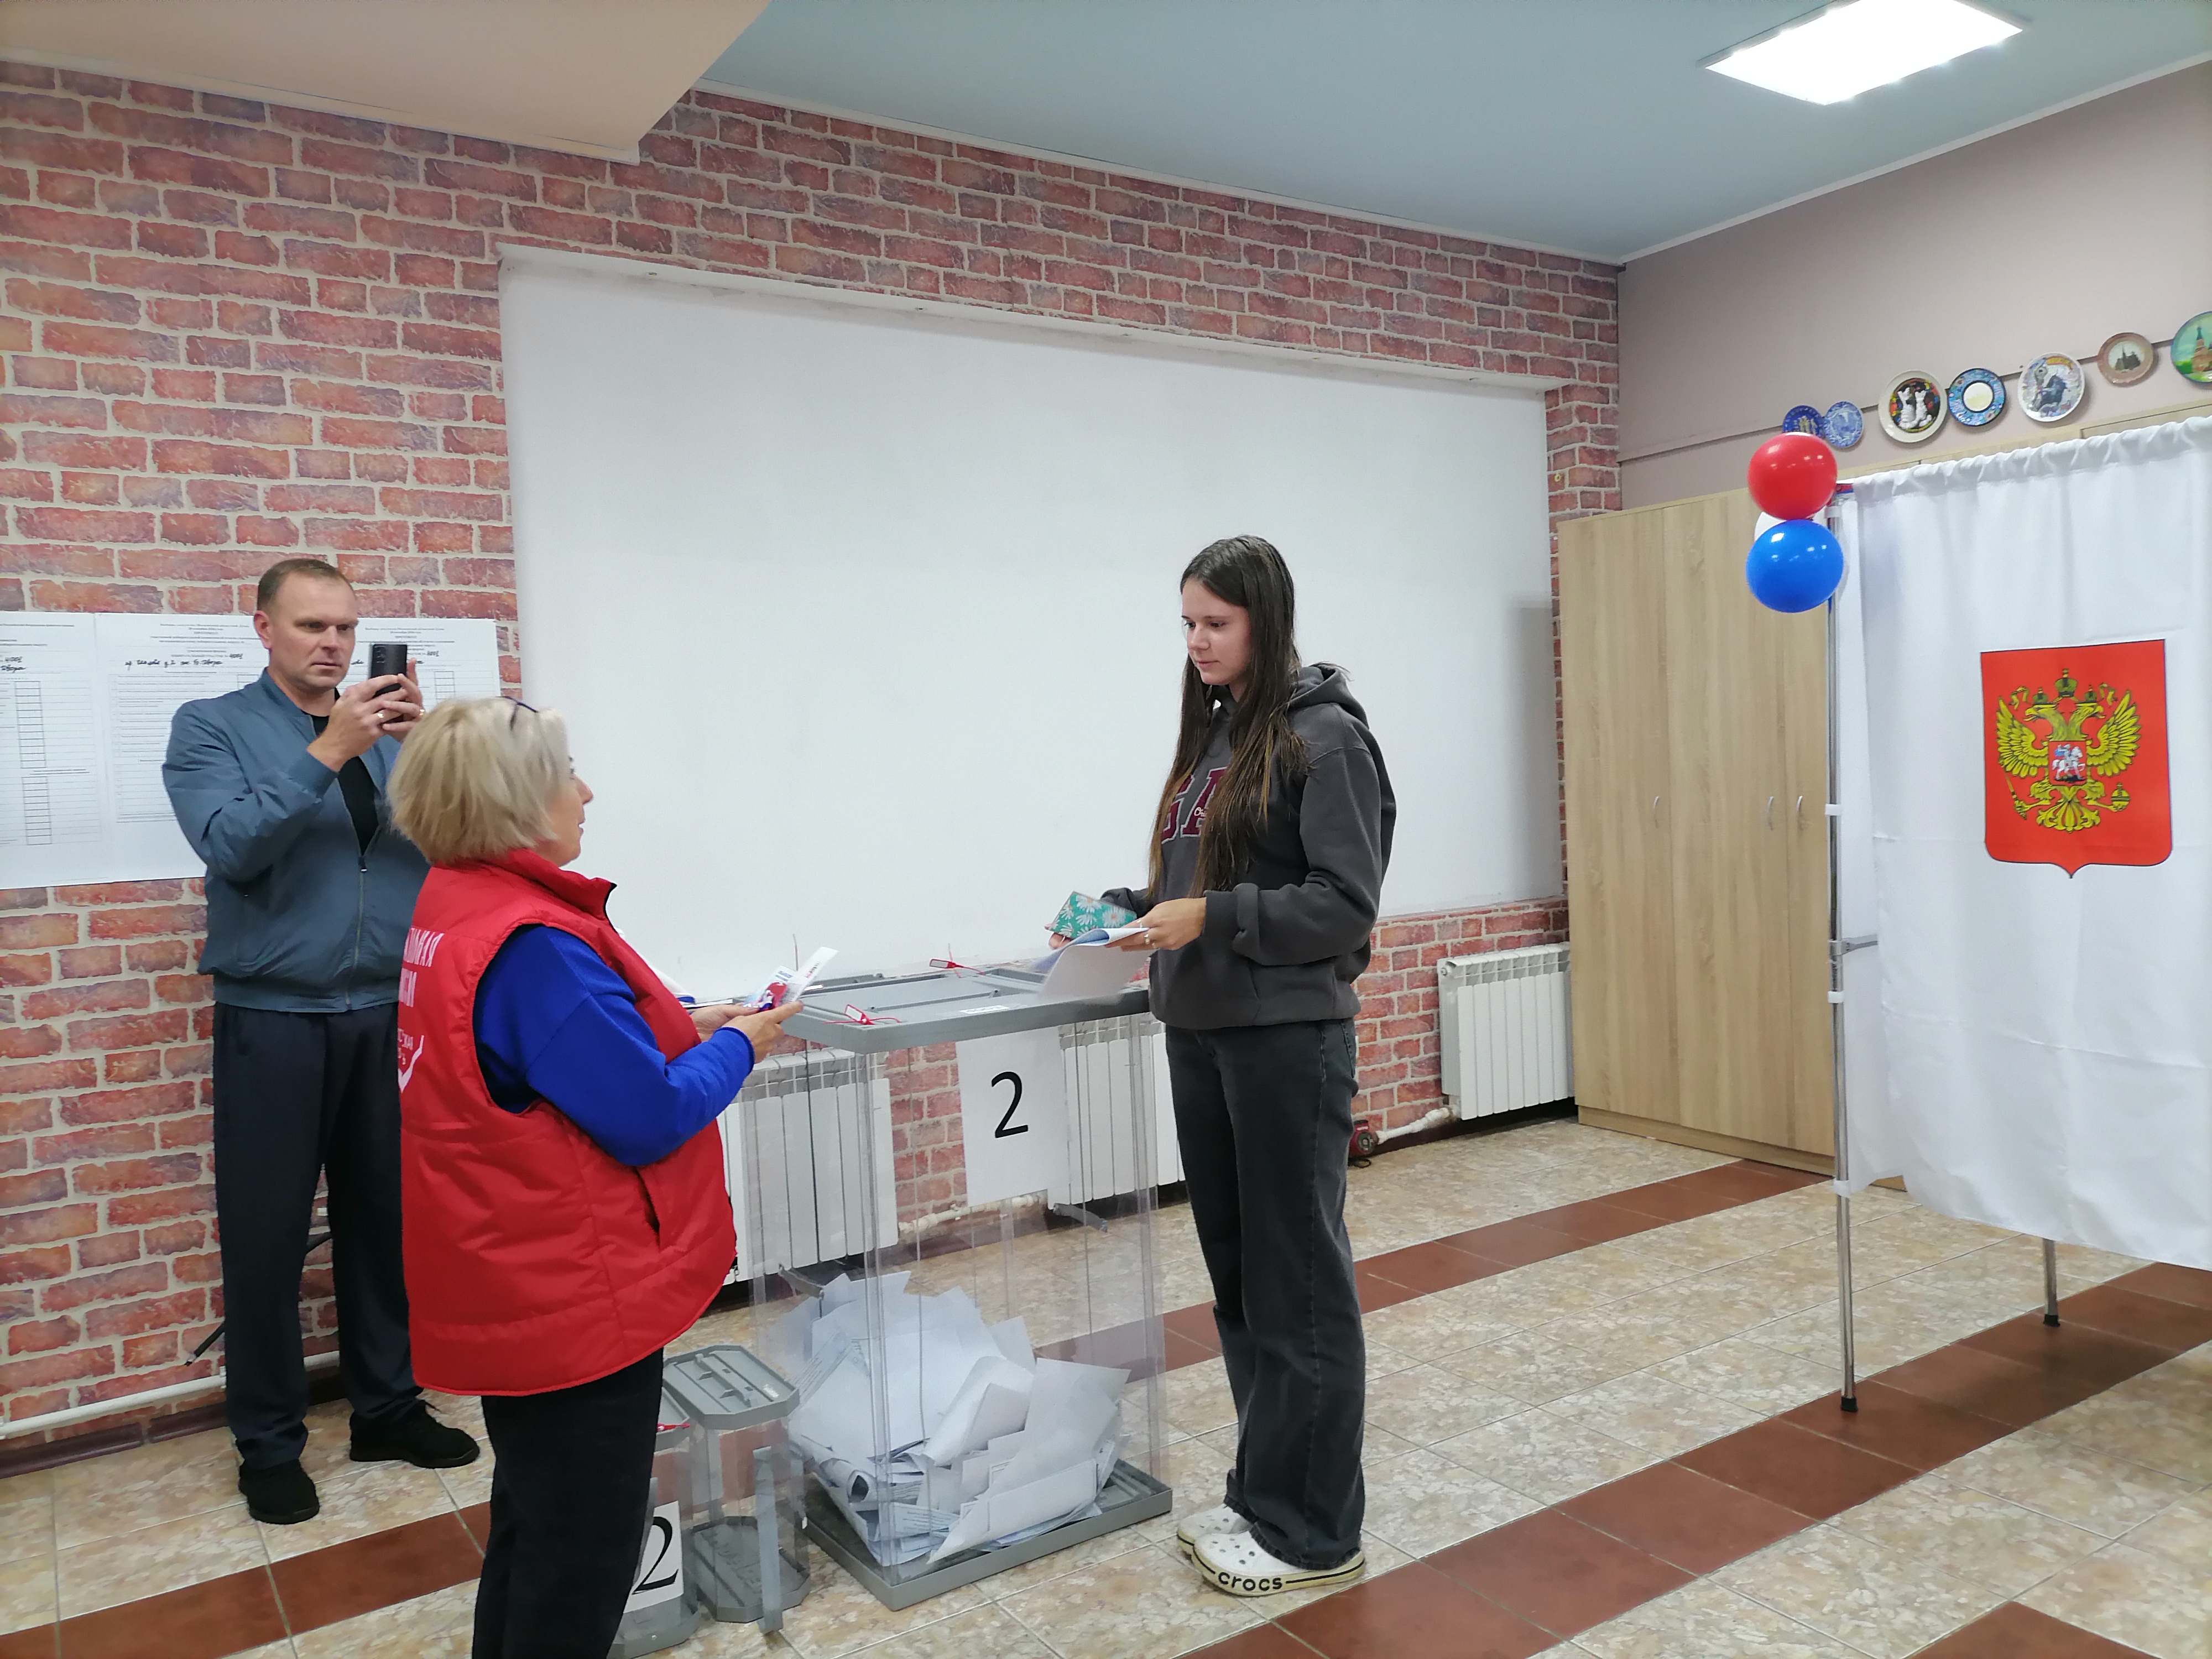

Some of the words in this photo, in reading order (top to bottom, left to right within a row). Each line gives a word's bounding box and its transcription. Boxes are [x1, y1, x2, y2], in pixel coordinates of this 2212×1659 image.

[992, 1071, 1028, 1138] 2
[632, 1516, 679, 1595] 2
[1218, 1572, 1282, 1591] crocs
